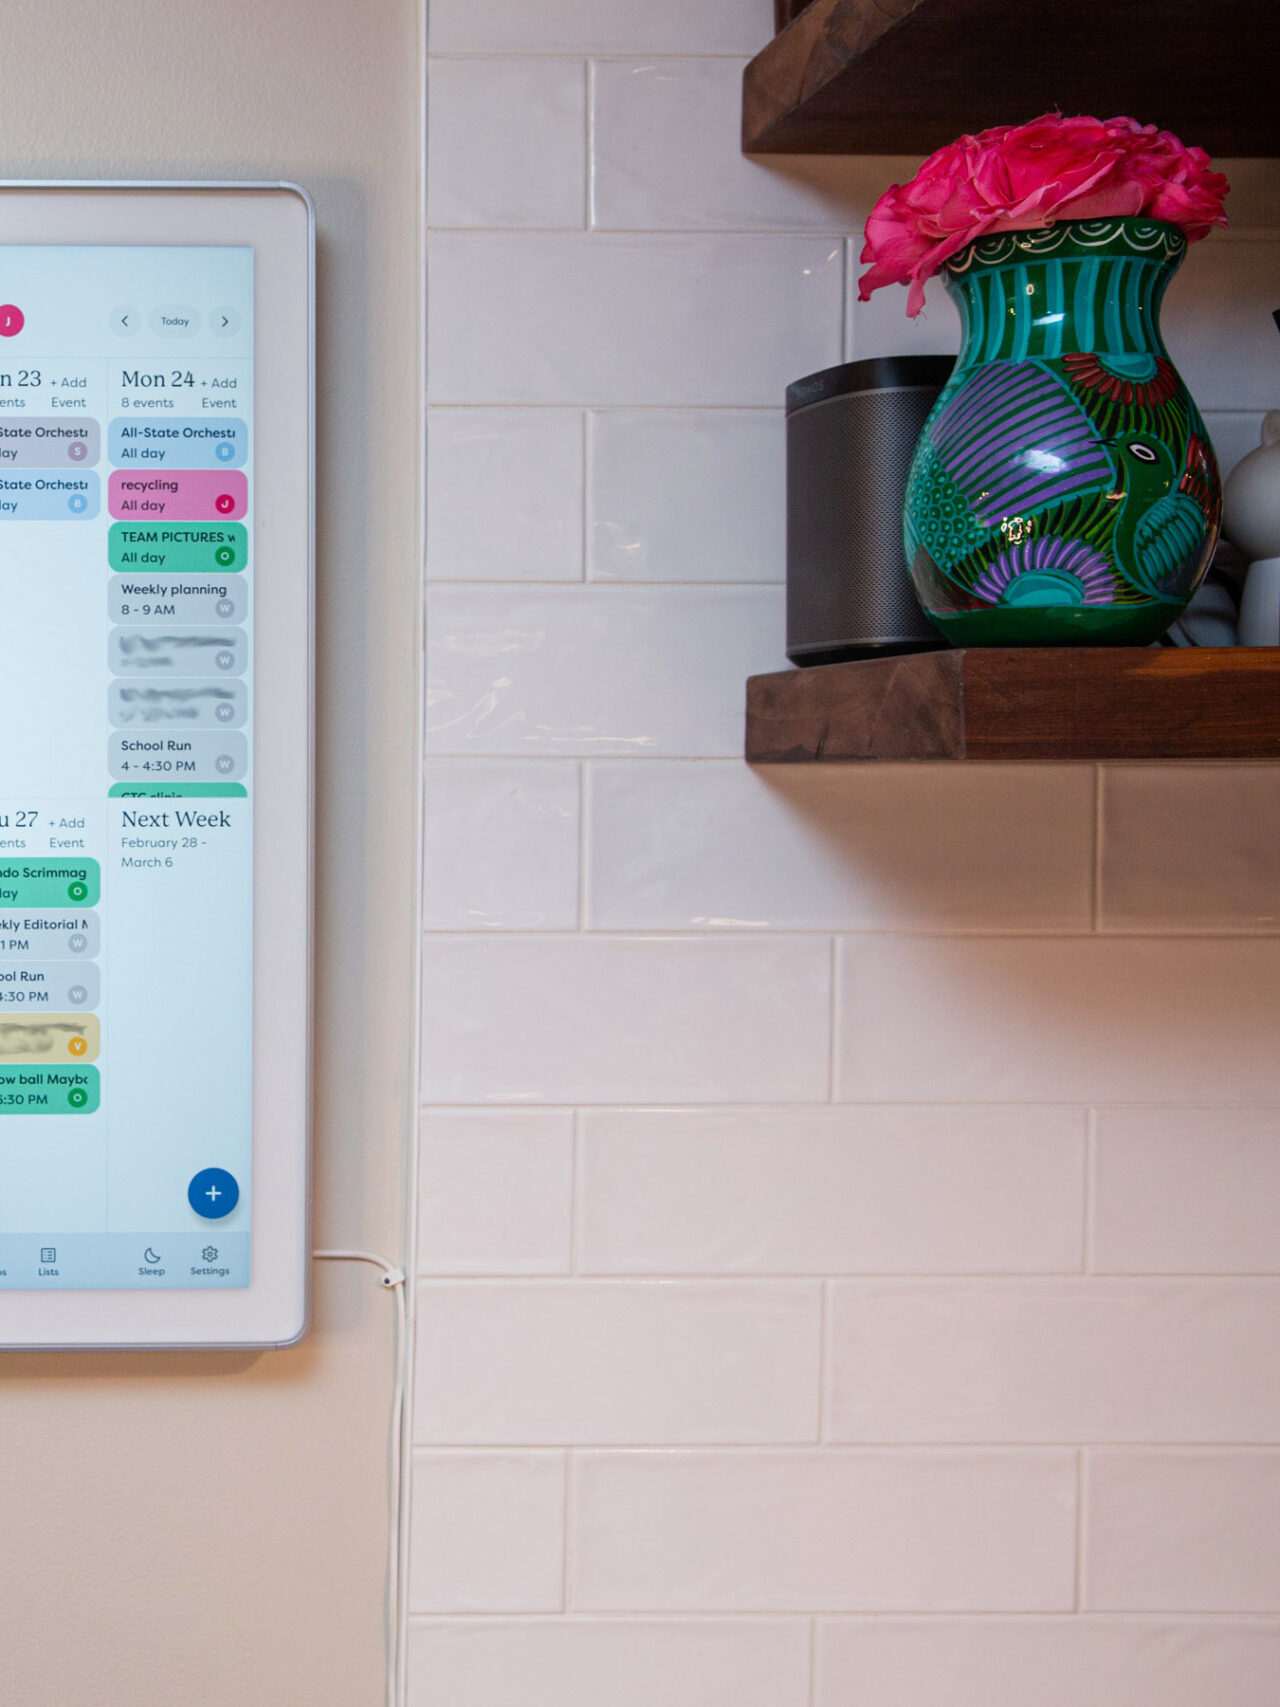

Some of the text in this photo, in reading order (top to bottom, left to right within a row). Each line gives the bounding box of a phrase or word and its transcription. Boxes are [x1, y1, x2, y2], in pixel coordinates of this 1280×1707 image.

[5, 316, 11, 327] J
[160, 316, 190, 328] Today
[17, 369, 42, 387] 23
[60, 376, 87, 389] Add
[121, 370, 195, 388] Mon 24
[211, 377, 238, 389] Add
[51, 396, 87, 408] Event
[121, 396, 175, 409] 8 events
[201, 397, 238, 409] Event
[120, 427, 180, 439] All-State
[120, 447, 166, 462] All day
[121, 479, 179, 494] recycling
[120, 499, 166, 514] All day
[120, 531, 225, 543] TEAM PICTURES
[120, 551, 166, 566] All day
[121, 583, 228, 598] Weekly planning
[121, 739, 192, 751] School Run
[15, 810, 39, 828] 27
[58, 817, 85, 829] Add
[122, 810, 232, 828] Next Week
[49, 837, 85, 849] Event
[121, 836, 198, 851] February 28
[121, 856, 174, 868] March 6
[22, 867, 87, 881] Scrimmag
[23, 918, 78, 930] Editorial
[20, 970, 45, 982] Run
[19, 1073, 44, 1085] ball
[37, 1267, 60, 1277] Lists
[138, 1266, 166, 1278] Sleep
[190, 1266, 230, 1278] Settings
